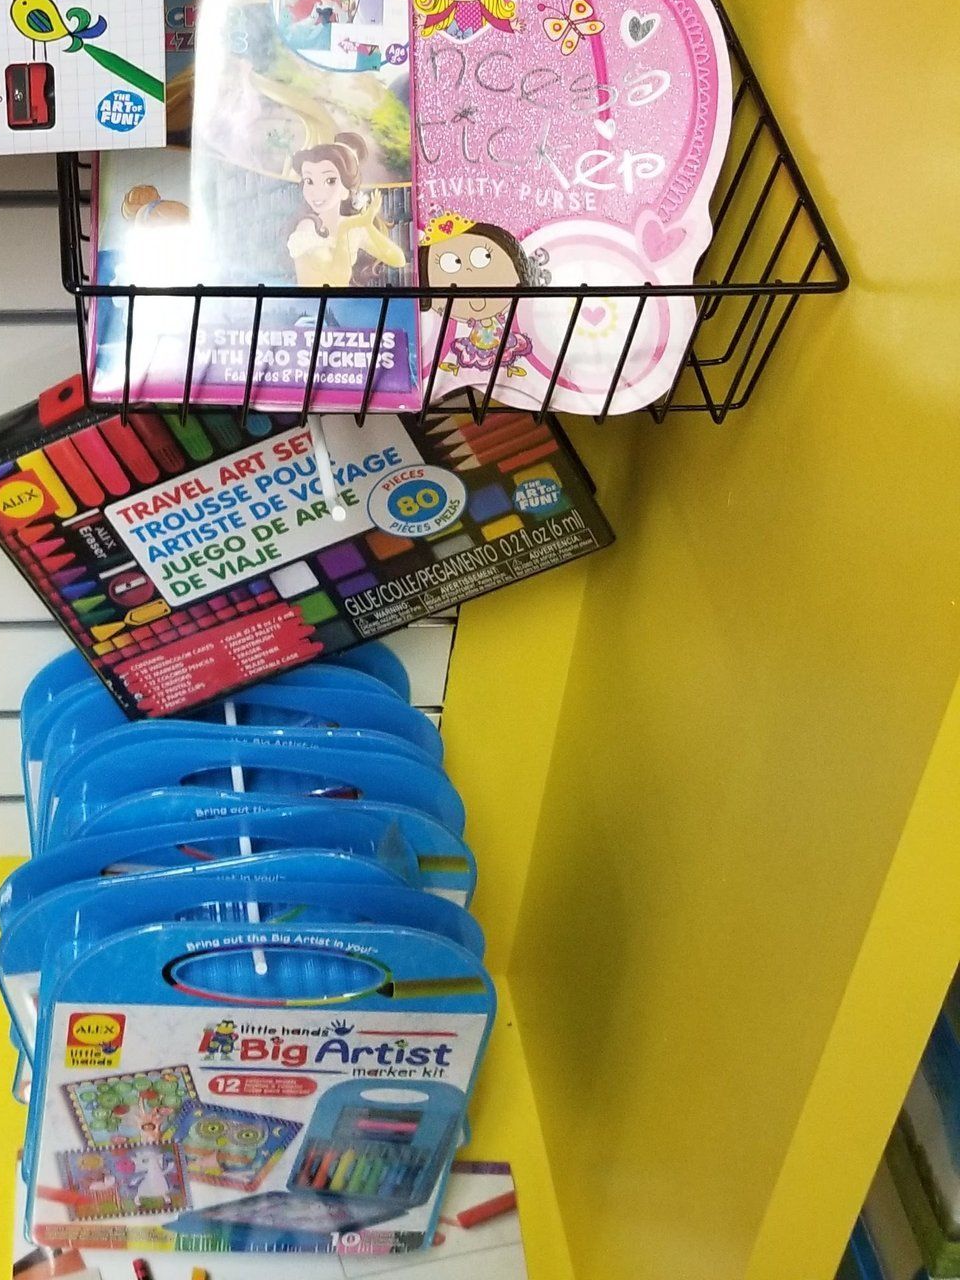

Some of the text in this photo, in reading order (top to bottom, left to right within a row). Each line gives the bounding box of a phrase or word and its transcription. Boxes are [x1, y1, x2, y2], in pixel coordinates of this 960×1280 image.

[520, 183, 597, 211] PURSE
[214, 330, 296, 347] STICKER
[196, 351, 243, 367] WITH
[254, 350, 289, 366] 240
[116, 431, 315, 526] TRAVEL ART SET
[382, 469, 425, 491] PIECES
[2, 488, 38, 512] ALEX
[128, 483, 253, 545] TROUSSE
[147, 445, 404, 564] ARTISTE DE VOYAGE
[397, 488, 440, 518] 80
[435, 498, 461, 527] PIEZAS
[161, 517, 290, 582] JUEGO DE
[169, 542, 283, 598] DE VIAJE
[344, 545, 498, 616] GLUE/COLLE/PEGAMENTO
[186, 937, 219, 952] Bring
[224, 935, 243, 944] out
[247, 933, 267, 943] the
[271, 934, 291, 945] Big
[294, 934, 330, 947] Artist
[334, 938, 344, 948] in
[75, 1024, 115, 1034] ALEX
[240, 1024, 329, 1037] little hands
[240, 1037, 452, 1067] Big Artist
[216, 1078, 240, 1093] 12
[352, 1066, 445, 1078] marker kit
